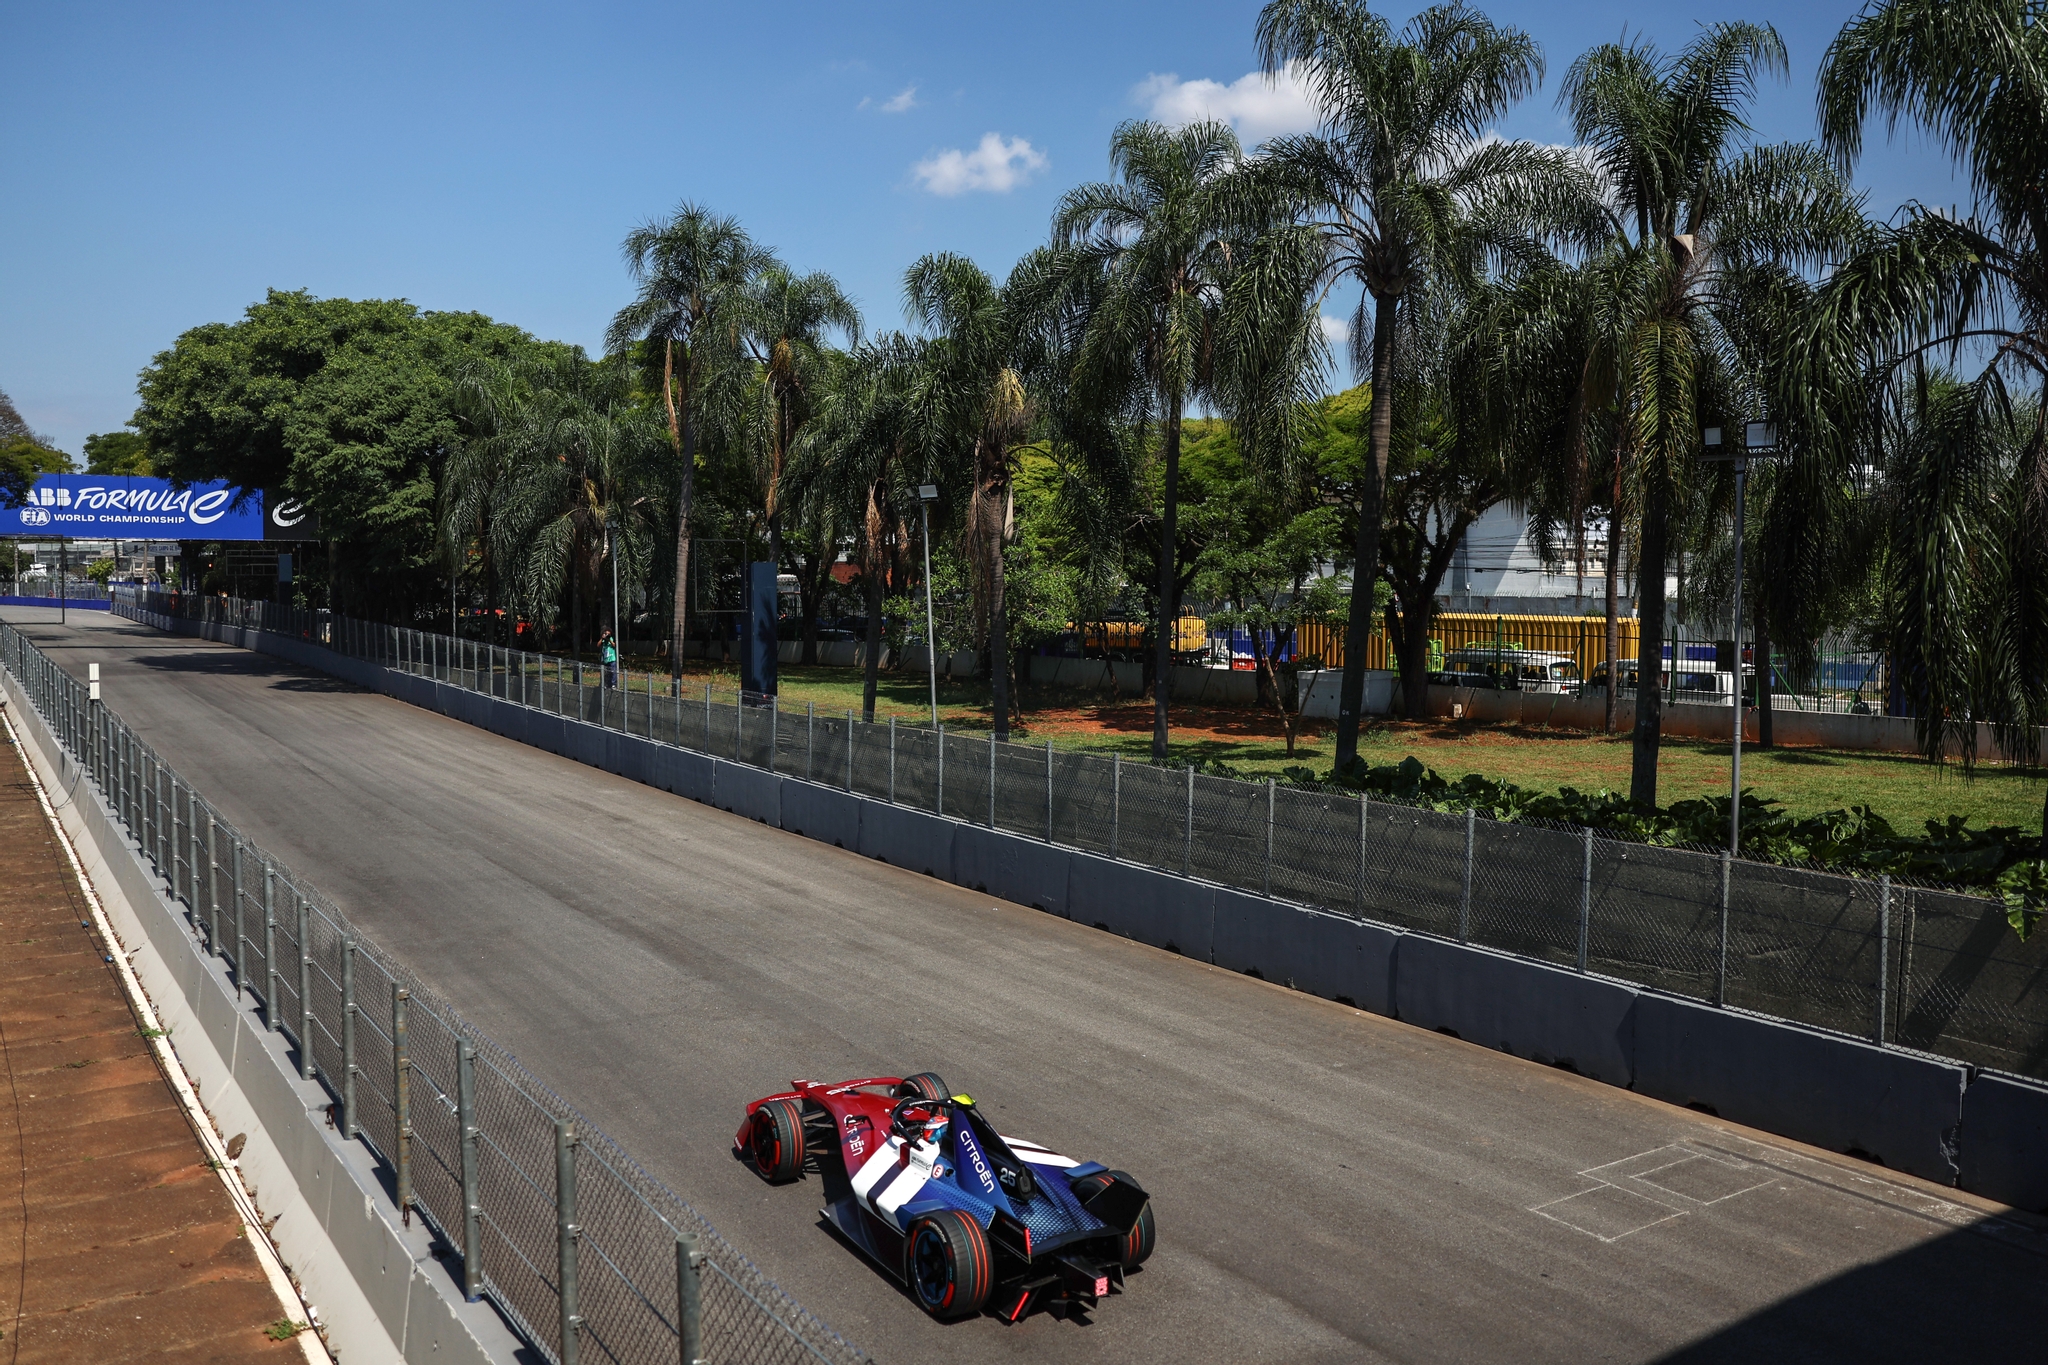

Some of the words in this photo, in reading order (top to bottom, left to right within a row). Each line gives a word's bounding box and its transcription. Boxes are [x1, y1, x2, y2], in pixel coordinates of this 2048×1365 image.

[25, 487, 72, 507] ABB
[73, 486, 193, 513] FORMULA
[53, 514, 95, 522] WORLD
[99, 514, 186, 524] CHAMPIONSHIP
[843, 1113, 865, 1157] CTROËN
[960, 1130, 995, 1194] CITROËN
[1000, 1167, 1017, 1187] 25
